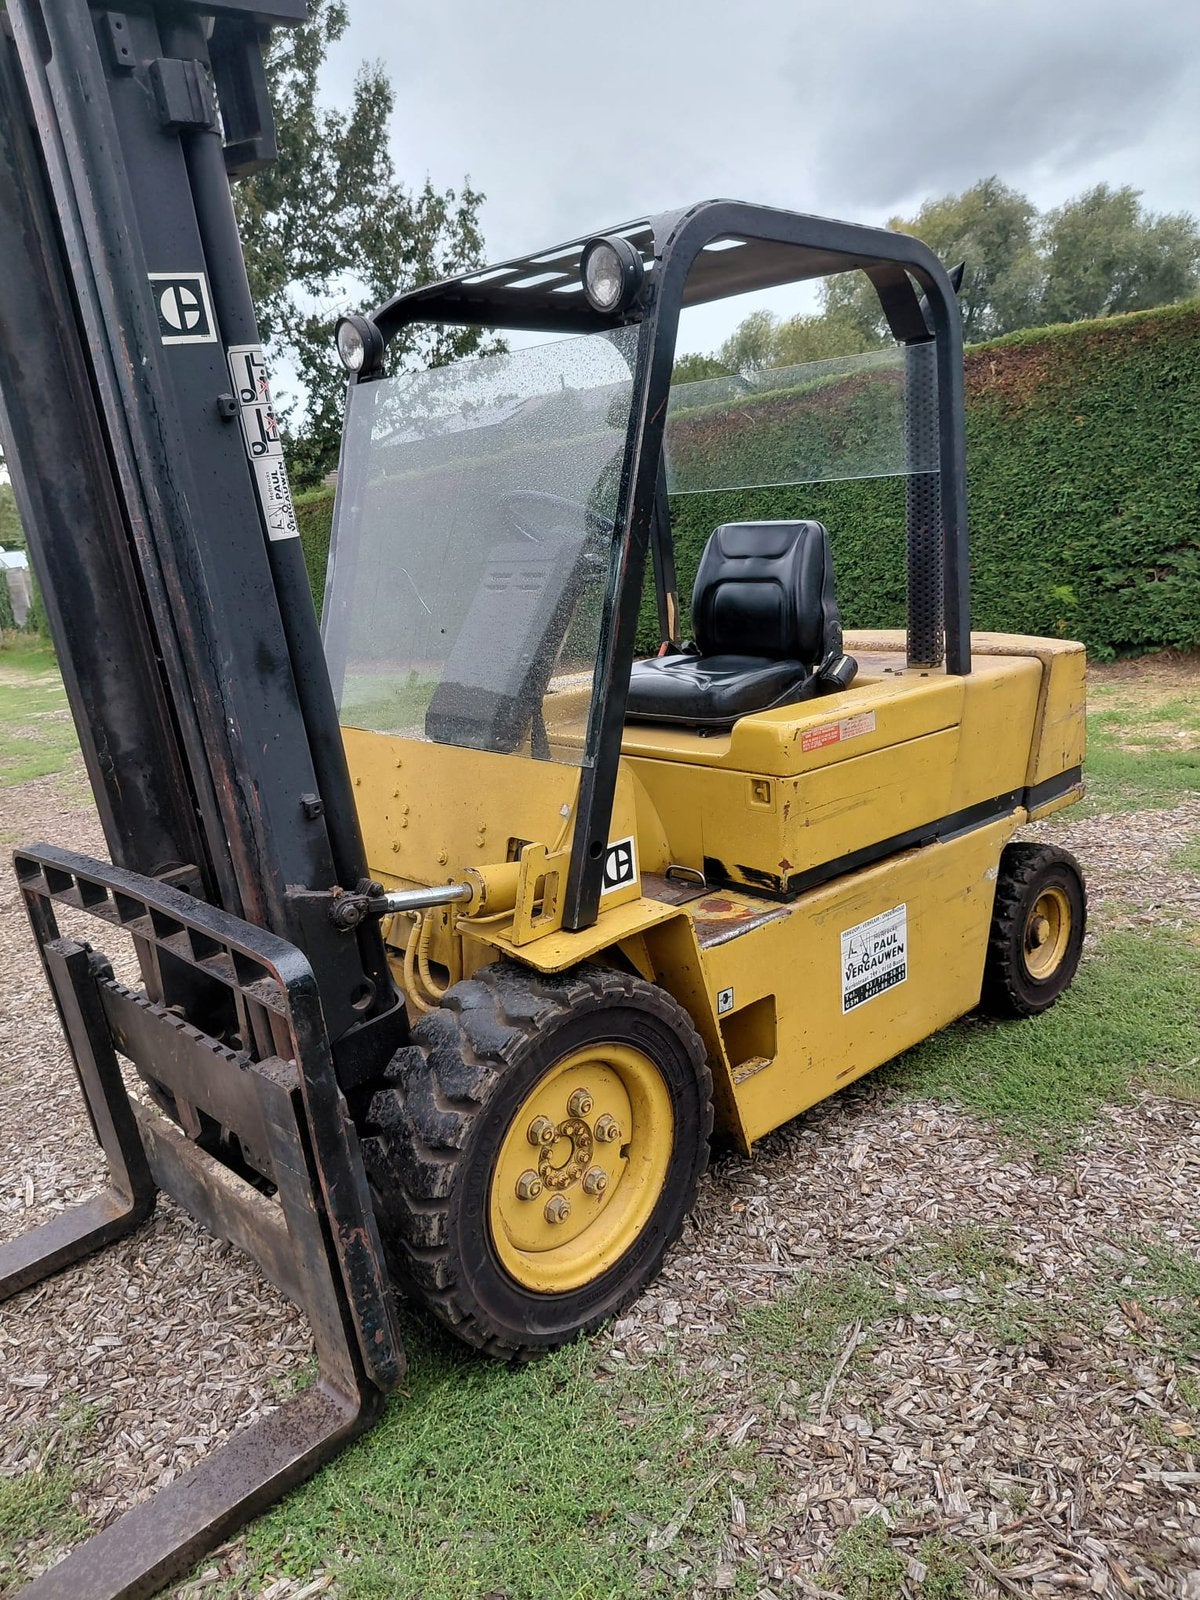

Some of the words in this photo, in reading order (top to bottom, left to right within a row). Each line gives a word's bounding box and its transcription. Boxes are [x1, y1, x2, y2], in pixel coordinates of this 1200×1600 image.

[271, 469, 283, 500] PAUL
[873, 933, 898, 953] PAUL
[845, 943, 904, 981] VERGAUWEN
[845, 996, 859, 1009] GSM
